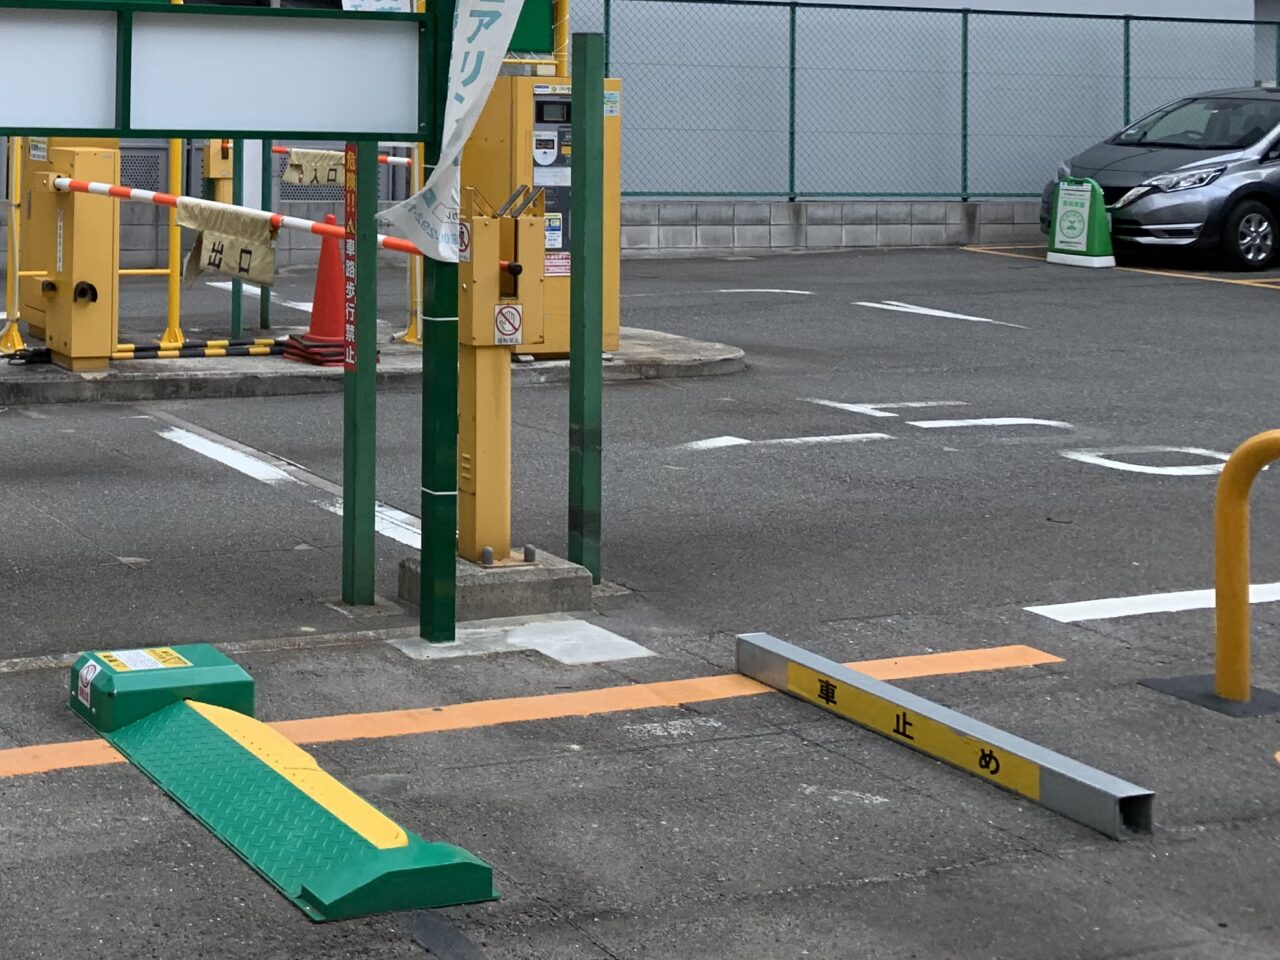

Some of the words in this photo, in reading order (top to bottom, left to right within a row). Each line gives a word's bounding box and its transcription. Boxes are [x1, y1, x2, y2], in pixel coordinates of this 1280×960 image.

[207, 240, 253, 275] 出口
[817, 679, 1001, 775] 車止め
